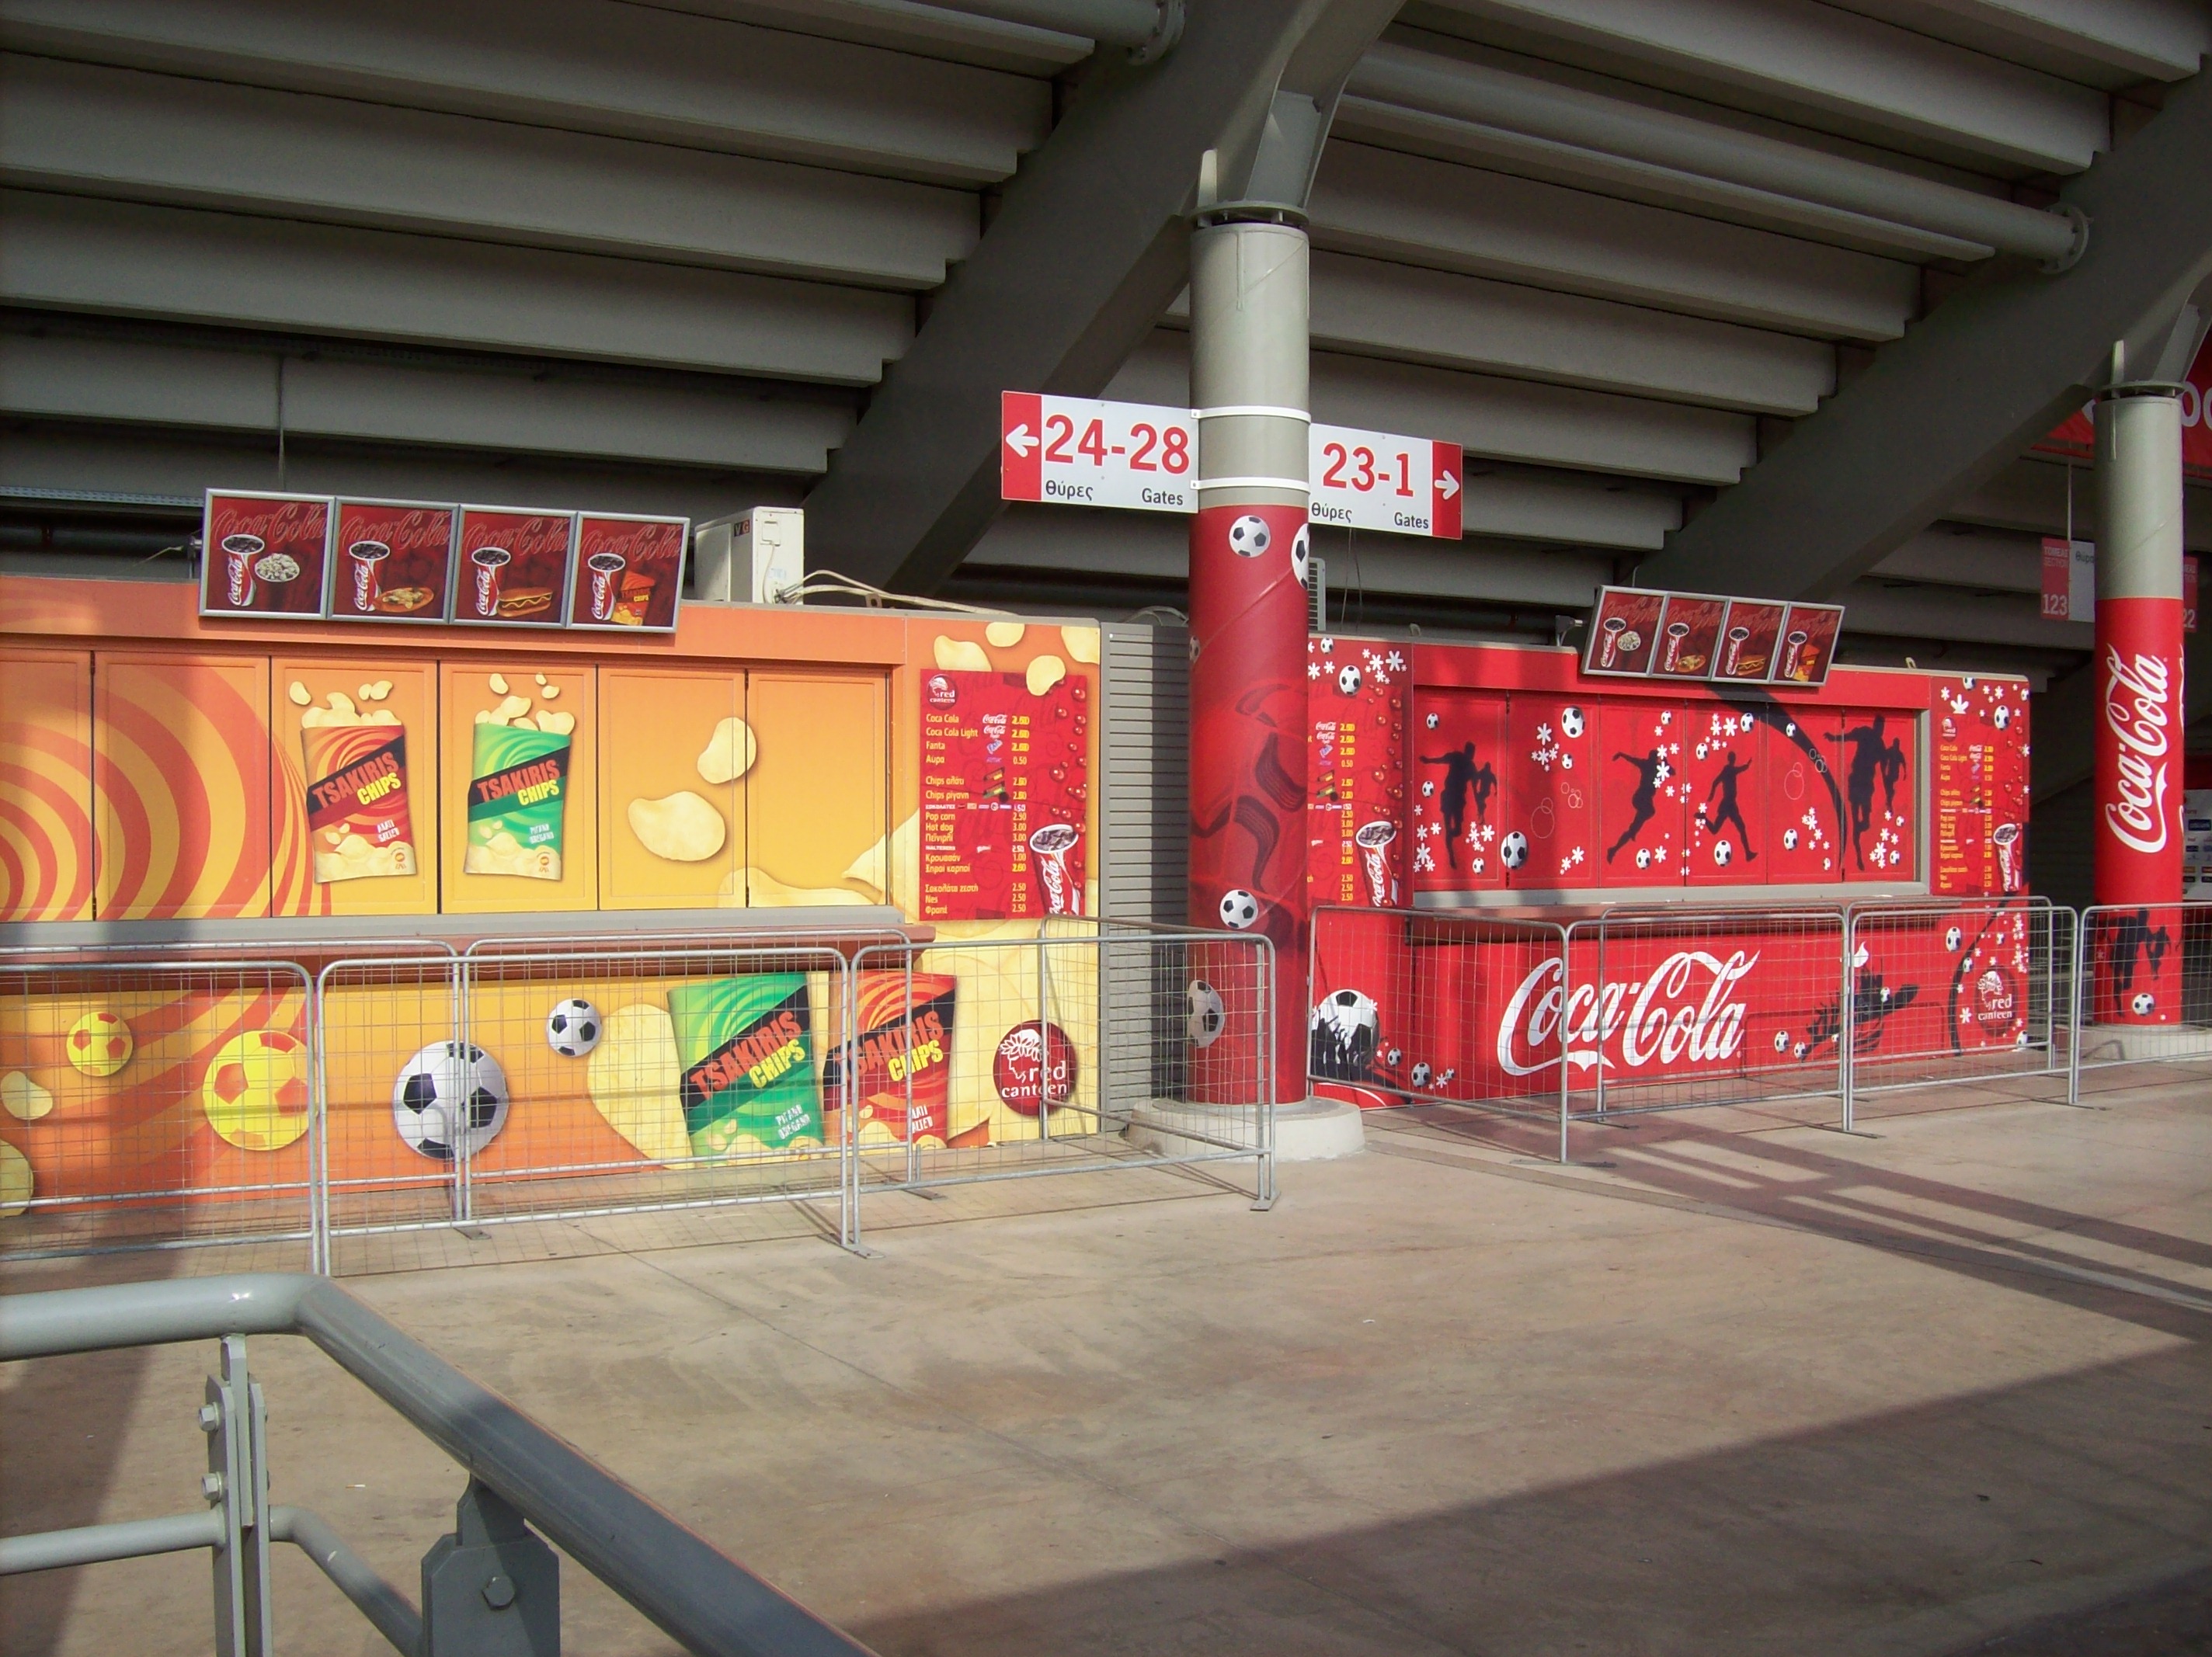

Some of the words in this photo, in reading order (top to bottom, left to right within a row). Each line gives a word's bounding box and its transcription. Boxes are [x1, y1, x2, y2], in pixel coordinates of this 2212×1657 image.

[1044, 413, 1191, 475] 24-28
[1323, 443, 1414, 498] 23-1
[1142, 488, 1184, 506] Gates
[1394, 512, 1429, 530] Gates
[2043, 594, 2068, 616] 123
[927, 728, 942, 736] Coca
[944, 728, 958, 736] Cola
[961, 728, 978, 738] Light
[927, 741, 945, 749] Fanta
[1013, 756, 1027, 765] 0.50
[311, 752, 399, 808] TSAKIRIS
[357, 772, 401, 805] CHIPS
[477, 759, 560, 802] TSAKIRIS
[926, 776, 944, 787] Chips
[518, 780, 559, 805] CHIPS
[926, 790, 944, 801] Chips
[926, 812, 938, 822] Pop
[941, 824, 954, 832] dog
[1992, 994, 2012, 1009] red
[1497, 949, 1762, 1075] Coca-Cola
[1978, 1011, 2012, 1020] canteen
[690, 1011, 802, 1099] TSAKIRIS
[749, 1039, 805, 1088] CHIPS
